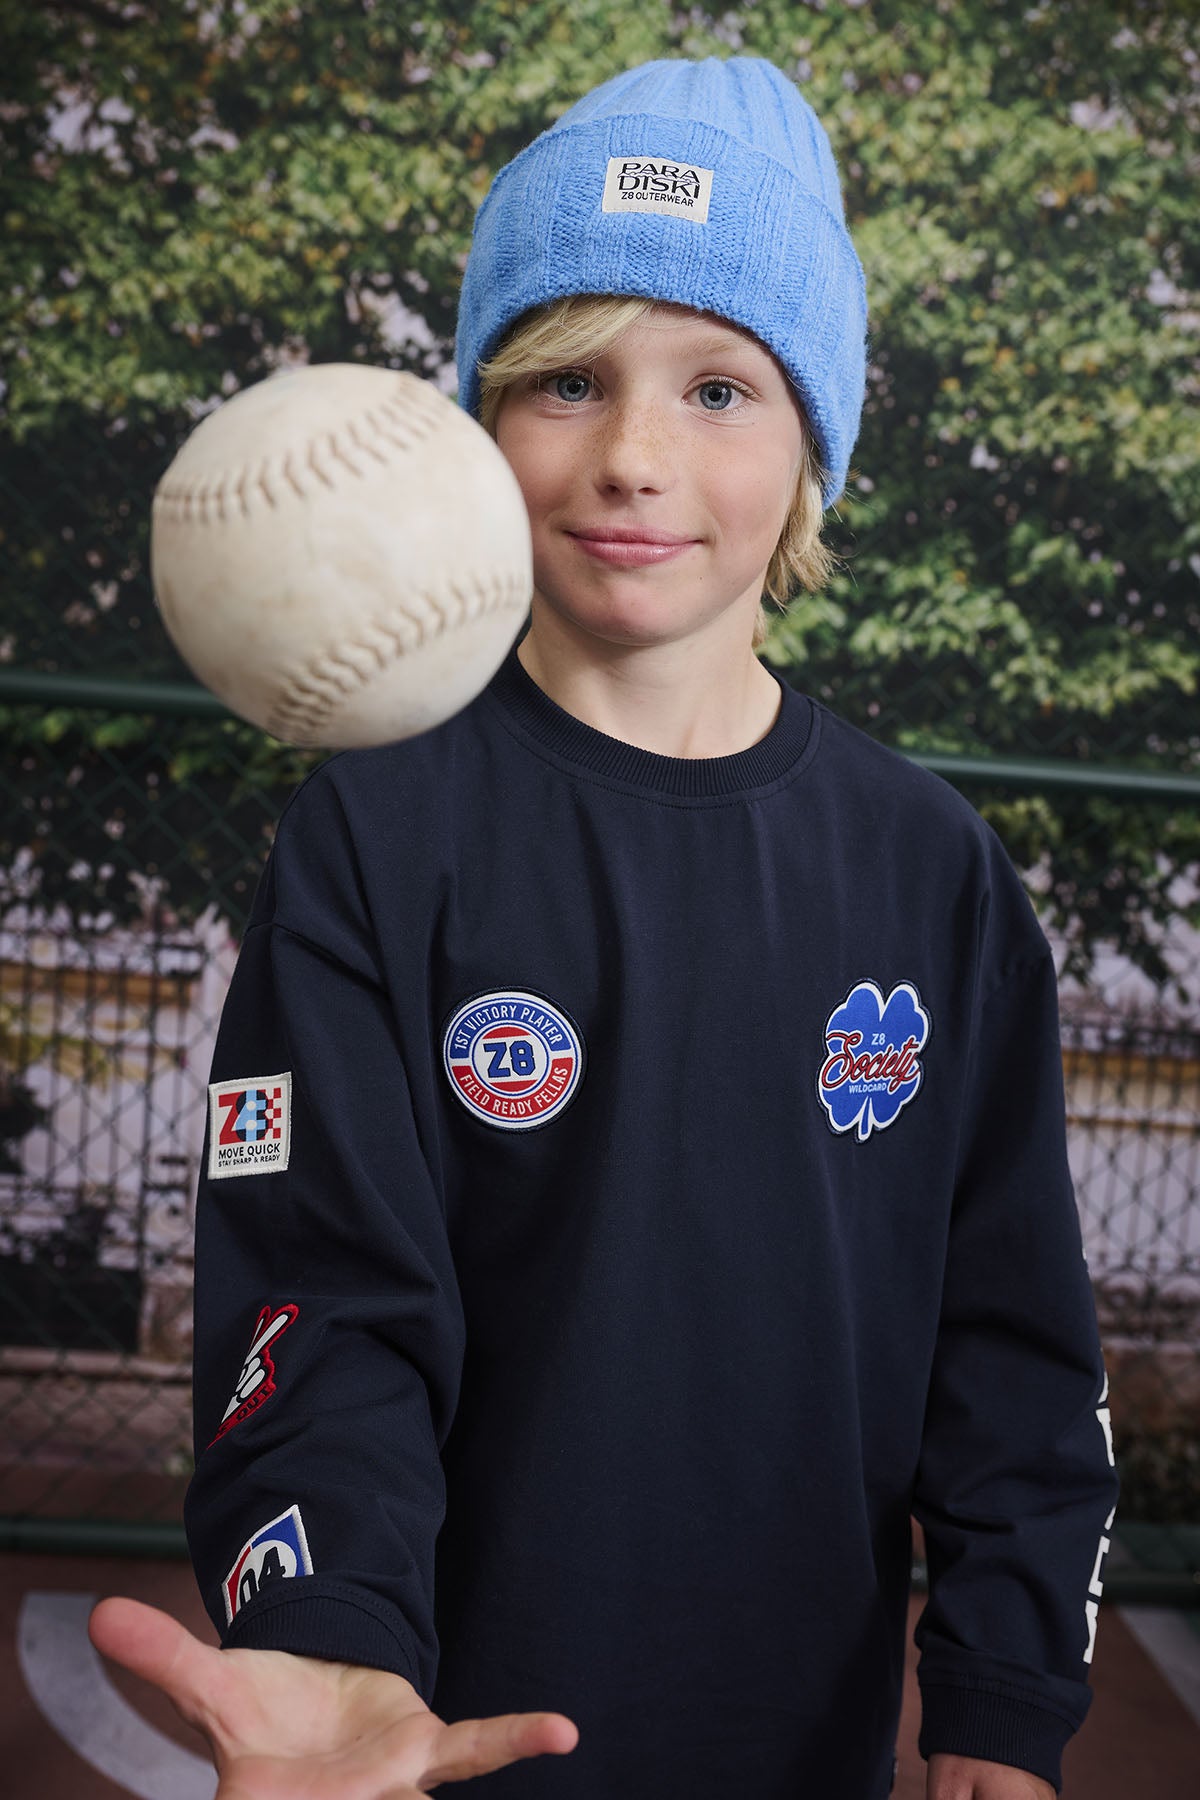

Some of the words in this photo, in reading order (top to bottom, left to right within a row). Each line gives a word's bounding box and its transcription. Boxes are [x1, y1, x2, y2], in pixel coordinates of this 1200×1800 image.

[621, 162, 700, 183] PARA
[618, 175, 700, 199] DISKI
[621, 191, 634, 200] Z8
[635, 192, 694, 207] OUTERWEAR
[454, 1029, 472, 1050] 1ST
[464, 1005, 517, 1029] VICTORY
[520, 1007, 563, 1045] PLAYER
[871, 1033, 886, 1046] Z8
[483, 1040, 536, 1078] Z8
[821, 1031, 921, 1093] Society
[459, 1073, 491, 1107] FIELD
[492, 1098, 533, 1115] READY
[533, 1066, 569, 1108] FELLAS
[848, 1082, 887, 1094] WILDCARD
[218, 1146, 244, 1160] MOVE
[247, 1142, 281, 1156] QUICK
[218, 1160, 231, 1168] STAY
[233, 1157, 252, 1166] SHARP
[260, 1154, 281, 1163] READY
